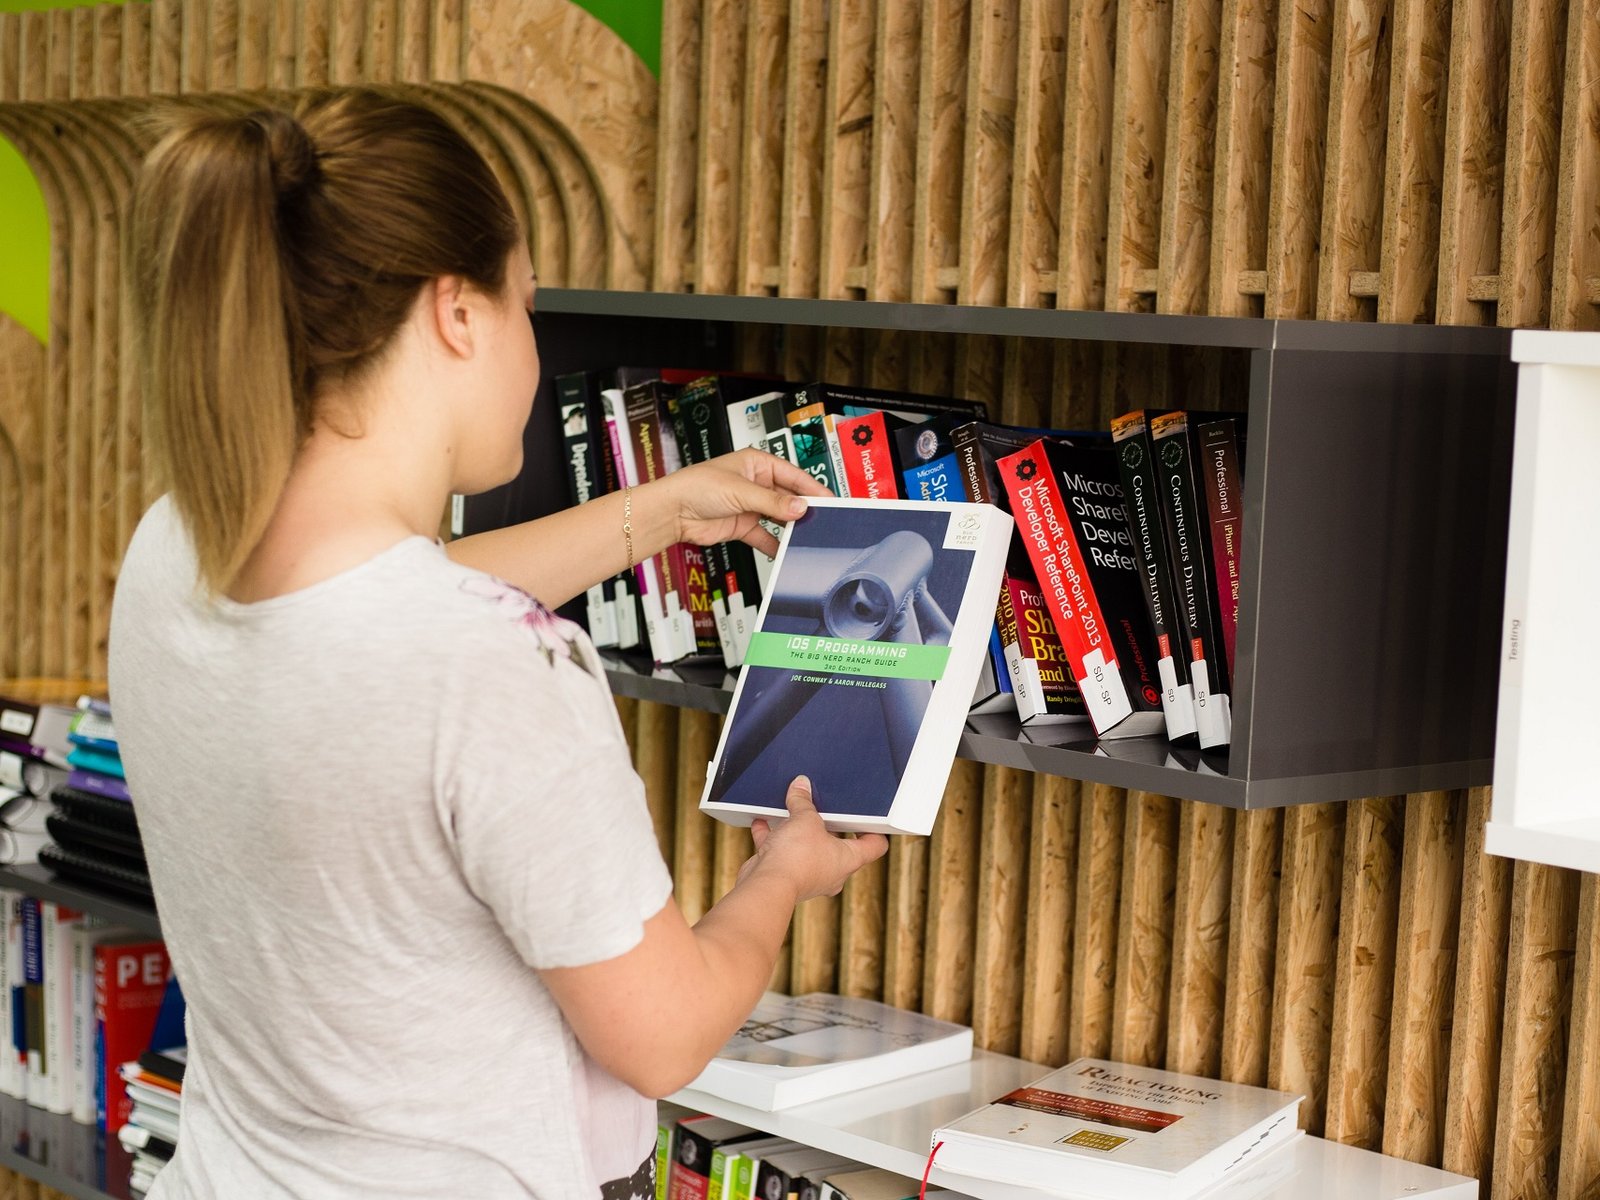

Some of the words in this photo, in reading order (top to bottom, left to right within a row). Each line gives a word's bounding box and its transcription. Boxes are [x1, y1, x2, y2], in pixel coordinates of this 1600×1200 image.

[860, 449, 876, 480] Inside
[917, 463, 945, 479] Microsoft
[964, 446, 984, 504] Professional
[1215, 449, 1231, 514] Professional
[1019, 486, 1051, 552] Developer
[1043, 555, 1074, 620] Reference
[1034, 477, 1064, 541] Microsoft
[1056, 540, 1088, 612] SharePoint
[1081, 611, 1102, 646] 2013
[1228, 560, 1238, 578] and
[736, 619, 745, 634] SD
[787, 637, 810, 651] iOS
[1120, 618, 1151, 682] Professional
[1509, 619, 1521, 662] Testing
[822, 654, 843, 662] NERD
[846, 656, 872, 665] RANCH
[875, 658, 898, 667] GUIDE
[803, 676, 827, 684] CONWAY
[834, 678, 854, 687] AARON
[855, 680, 888, 689] HILLEGASS
[1011, 659, 1020, 675] SD
[1017, 683, 1026, 699] SP
[1039, 666, 1065, 683] and
[1094, 666, 1105, 682] SD
[1101, 690, 1112, 705] SP
[1168, 688, 1175, 703] SD
[1198, 691, 1206, 707] SD
